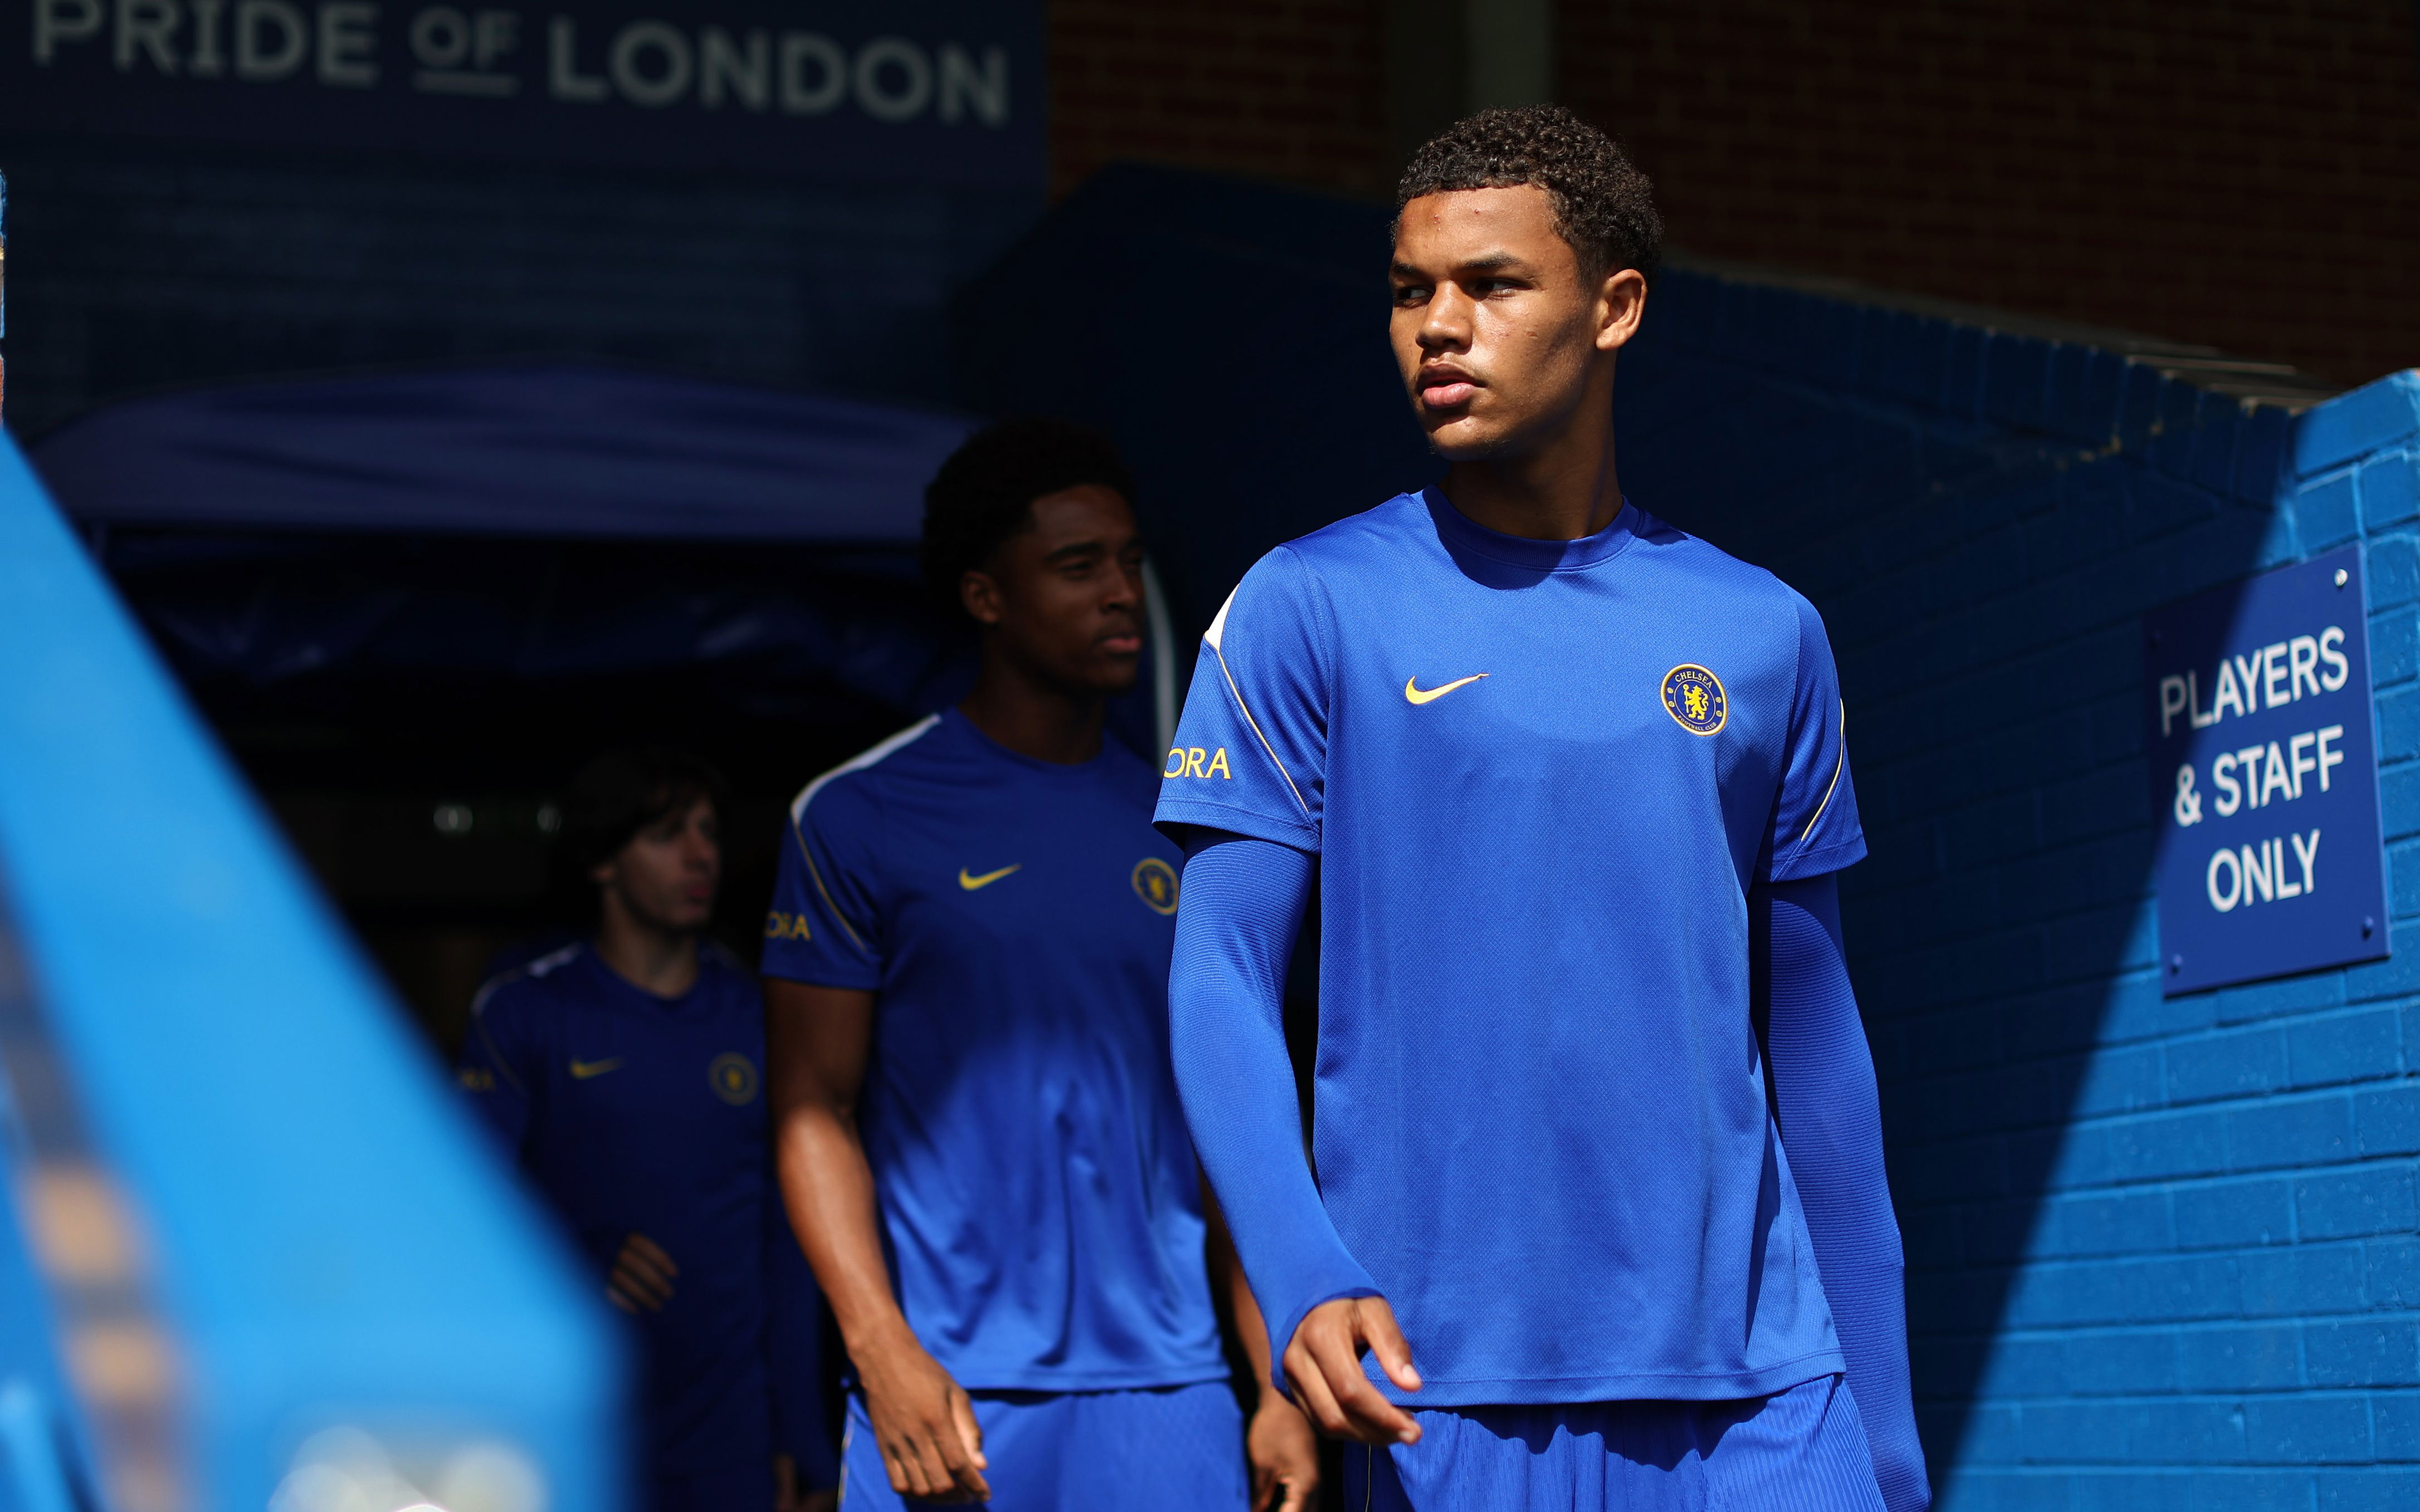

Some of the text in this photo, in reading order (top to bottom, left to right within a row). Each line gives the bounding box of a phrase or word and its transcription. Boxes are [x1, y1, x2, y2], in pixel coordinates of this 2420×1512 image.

[31, 0, 1012, 131] PRIDE OF LONDON
[1675, 671, 1712, 689] CHELSEA
[1677, 715, 1705, 731] FOOTBALL
[2159, 625, 2350, 737] PLAYERS
[2174, 724, 2344, 828] & STAFF
[2207, 828, 2321, 913] ONLY
